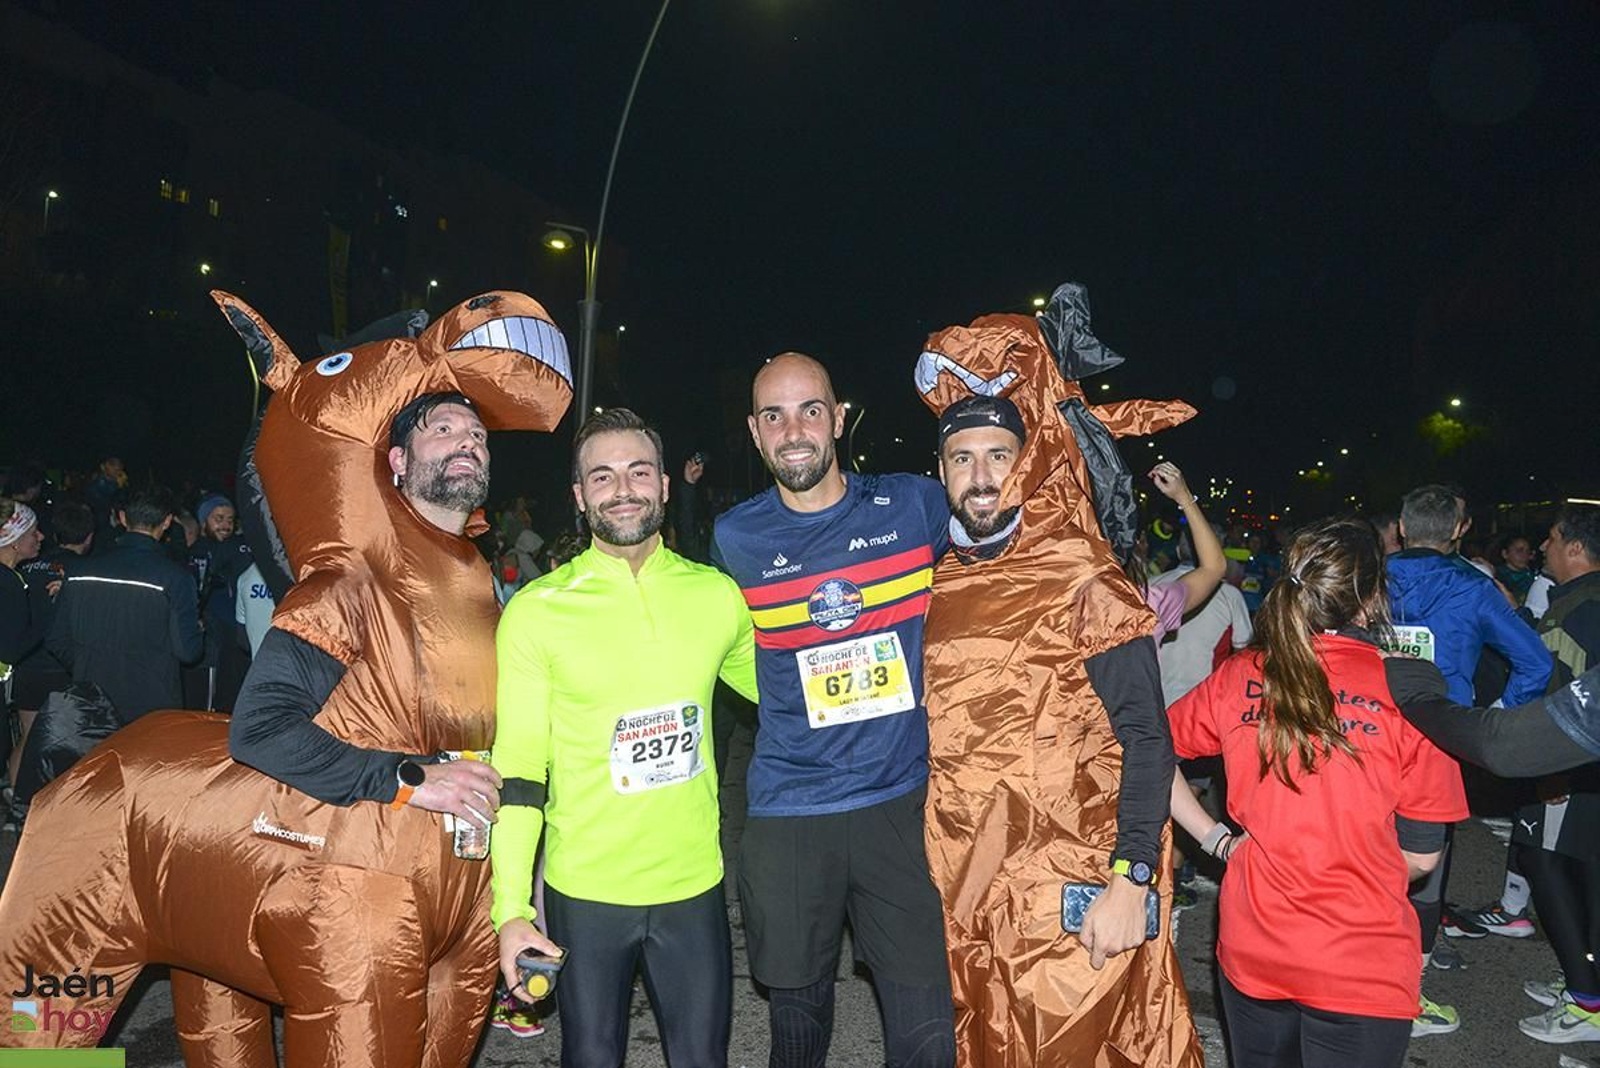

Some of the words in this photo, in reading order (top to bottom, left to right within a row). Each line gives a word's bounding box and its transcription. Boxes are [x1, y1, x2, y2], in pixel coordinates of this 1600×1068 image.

[869, 530, 898, 547] mupol
[762, 563, 802, 579] Santander
[820, 649, 853, 664] NOCHE
[811, 664, 833, 677] SAN
[825, 666, 888, 697] 6783
[628, 715, 663, 729] NOCHE
[663, 713, 676, 723] DE
[617, 730, 640, 743] SAN
[632, 731, 694, 764] 2372
